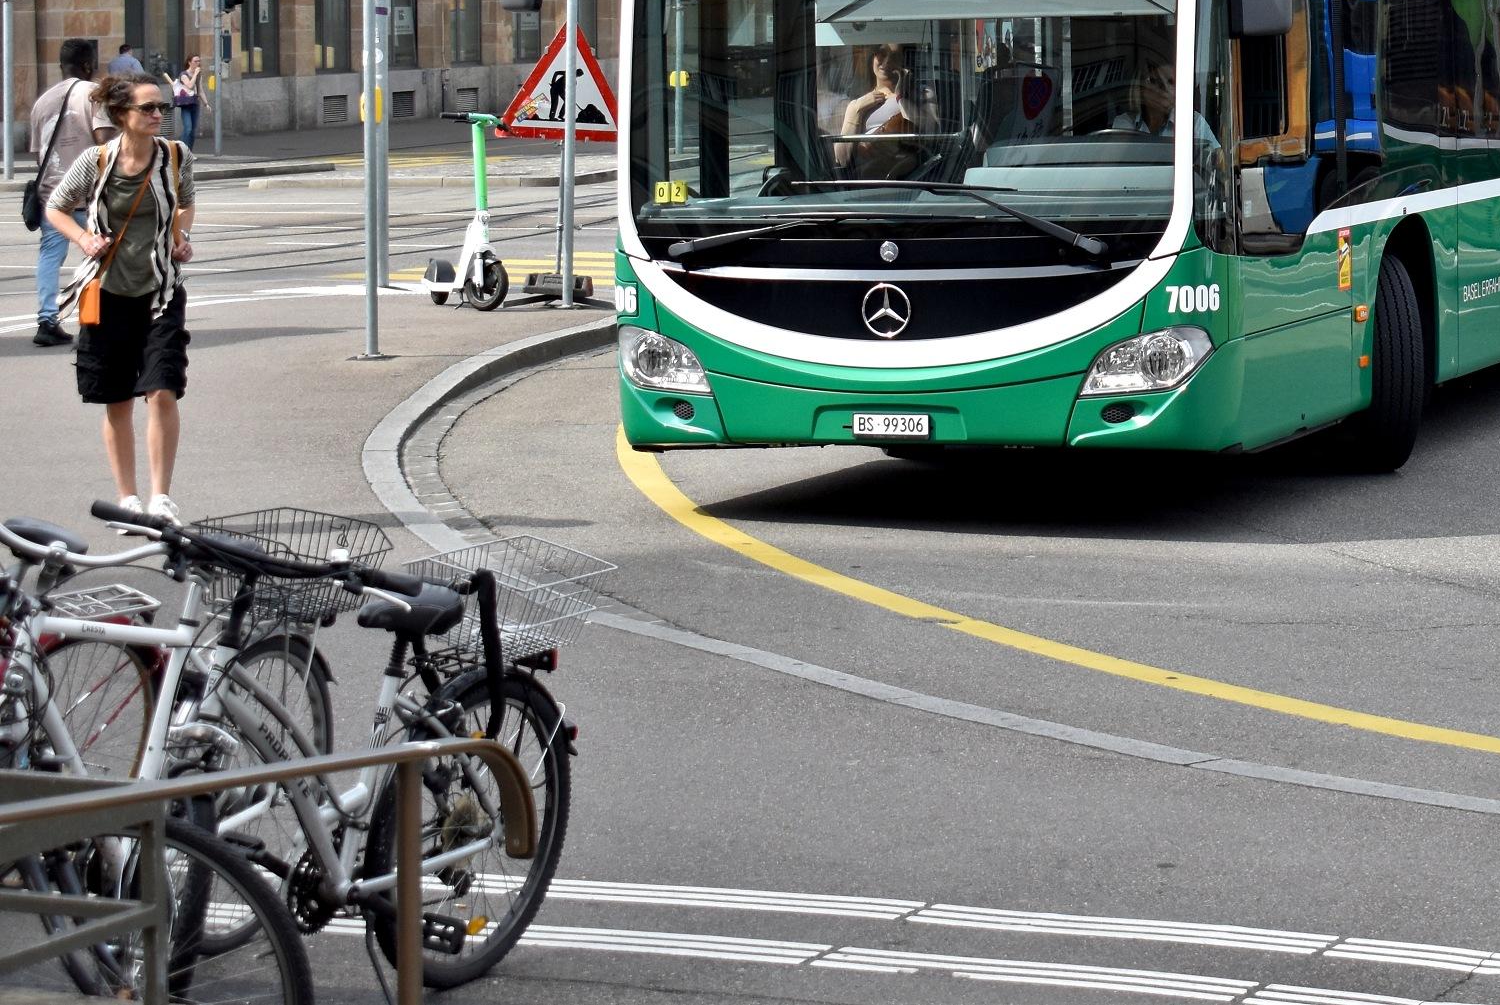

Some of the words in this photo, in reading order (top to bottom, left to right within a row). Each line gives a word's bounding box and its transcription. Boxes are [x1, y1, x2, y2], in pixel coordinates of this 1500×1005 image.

[1165, 283, 1220, 313] 7006
[1463, 281, 1482, 303] BASEL
[859, 417, 874, 432] BS
[883, 417, 924, 433] 99306
